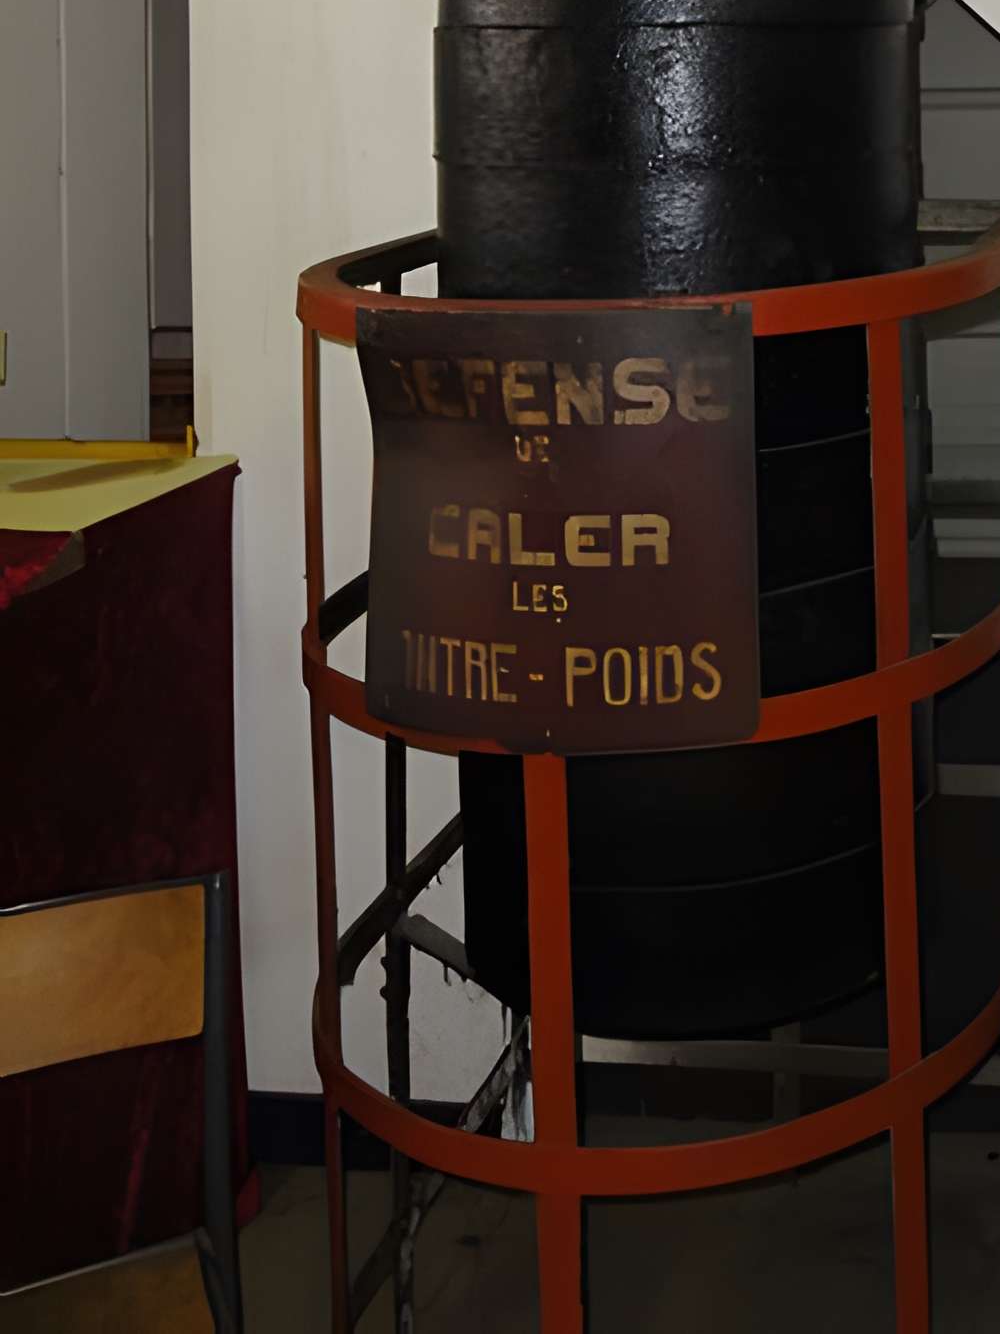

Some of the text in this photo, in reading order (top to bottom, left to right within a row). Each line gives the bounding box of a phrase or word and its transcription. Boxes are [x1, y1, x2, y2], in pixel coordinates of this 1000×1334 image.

[428, 503, 671, 568] CALER
[512, 581, 569, 613] LES
[564, 641, 723, 708] POIDS
